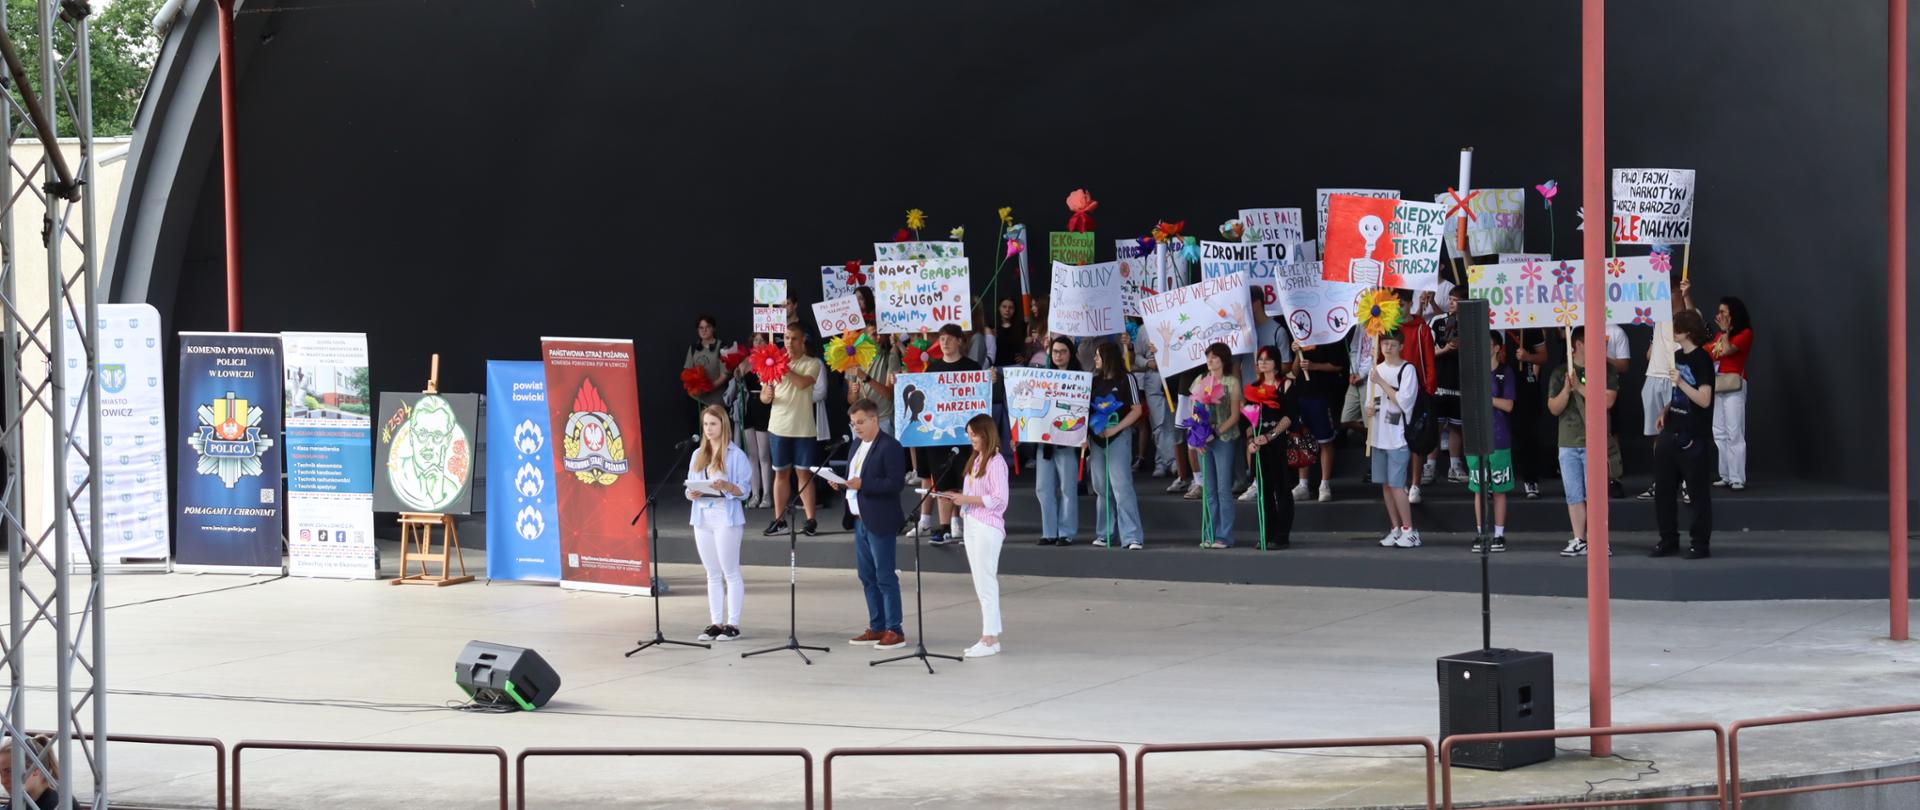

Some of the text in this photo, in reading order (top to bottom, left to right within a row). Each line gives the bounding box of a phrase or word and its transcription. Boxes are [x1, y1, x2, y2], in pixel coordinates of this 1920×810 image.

[1630, 186, 1687, 200] NARKOTYKI
[1394, 202, 1446, 225] KIEDYŚ
[1639, 201, 1680, 215] BARDZO
[1245, 212, 1270, 227] NIE
[1284, 227, 1301, 241] TYM
[1613, 215, 1690, 242] ZŁE NAWYKI
[1203, 243, 1258, 260] ZDROWIE
[1263, 243, 1286, 260] TO
[1392, 238, 1438, 255] TERAZ
[920, 265, 968, 280] GRABSKI
[1387, 259, 1438, 275] STRASZY
[1071, 265, 1114, 288] WOLNY
[889, 291, 943, 307] SZLUGOM
[932, 304, 963, 321] NIE
[1141, 297, 1164, 316] NIE
[1085, 307, 1112, 332] NIE
[187, 345, 275, 356] KOMENDA POWIATOWA
[549, 348, 585, 357] PAŃSTWOWA
[603, 350, 629, 360] POŻARNA
[216, 358, 247, 367] POLICJI
[208, 370, 254, 379] W ŁOWICZU
[938, 371, 988, 384] ALKOHOL
[513, 381, 543, 391] powiat
[950, 386, 976, 397] TOPI
[512, 392, 544, 401] łowicki
[101, 408, 133, 417] OWICZ
[936, 400, 986, 412] MARZENIA
[210, 444, 251, 454] POLICJA
[184, 506, 228, 514] POMAGAMY
[233, 507, 276, 517] CHRONIMY
